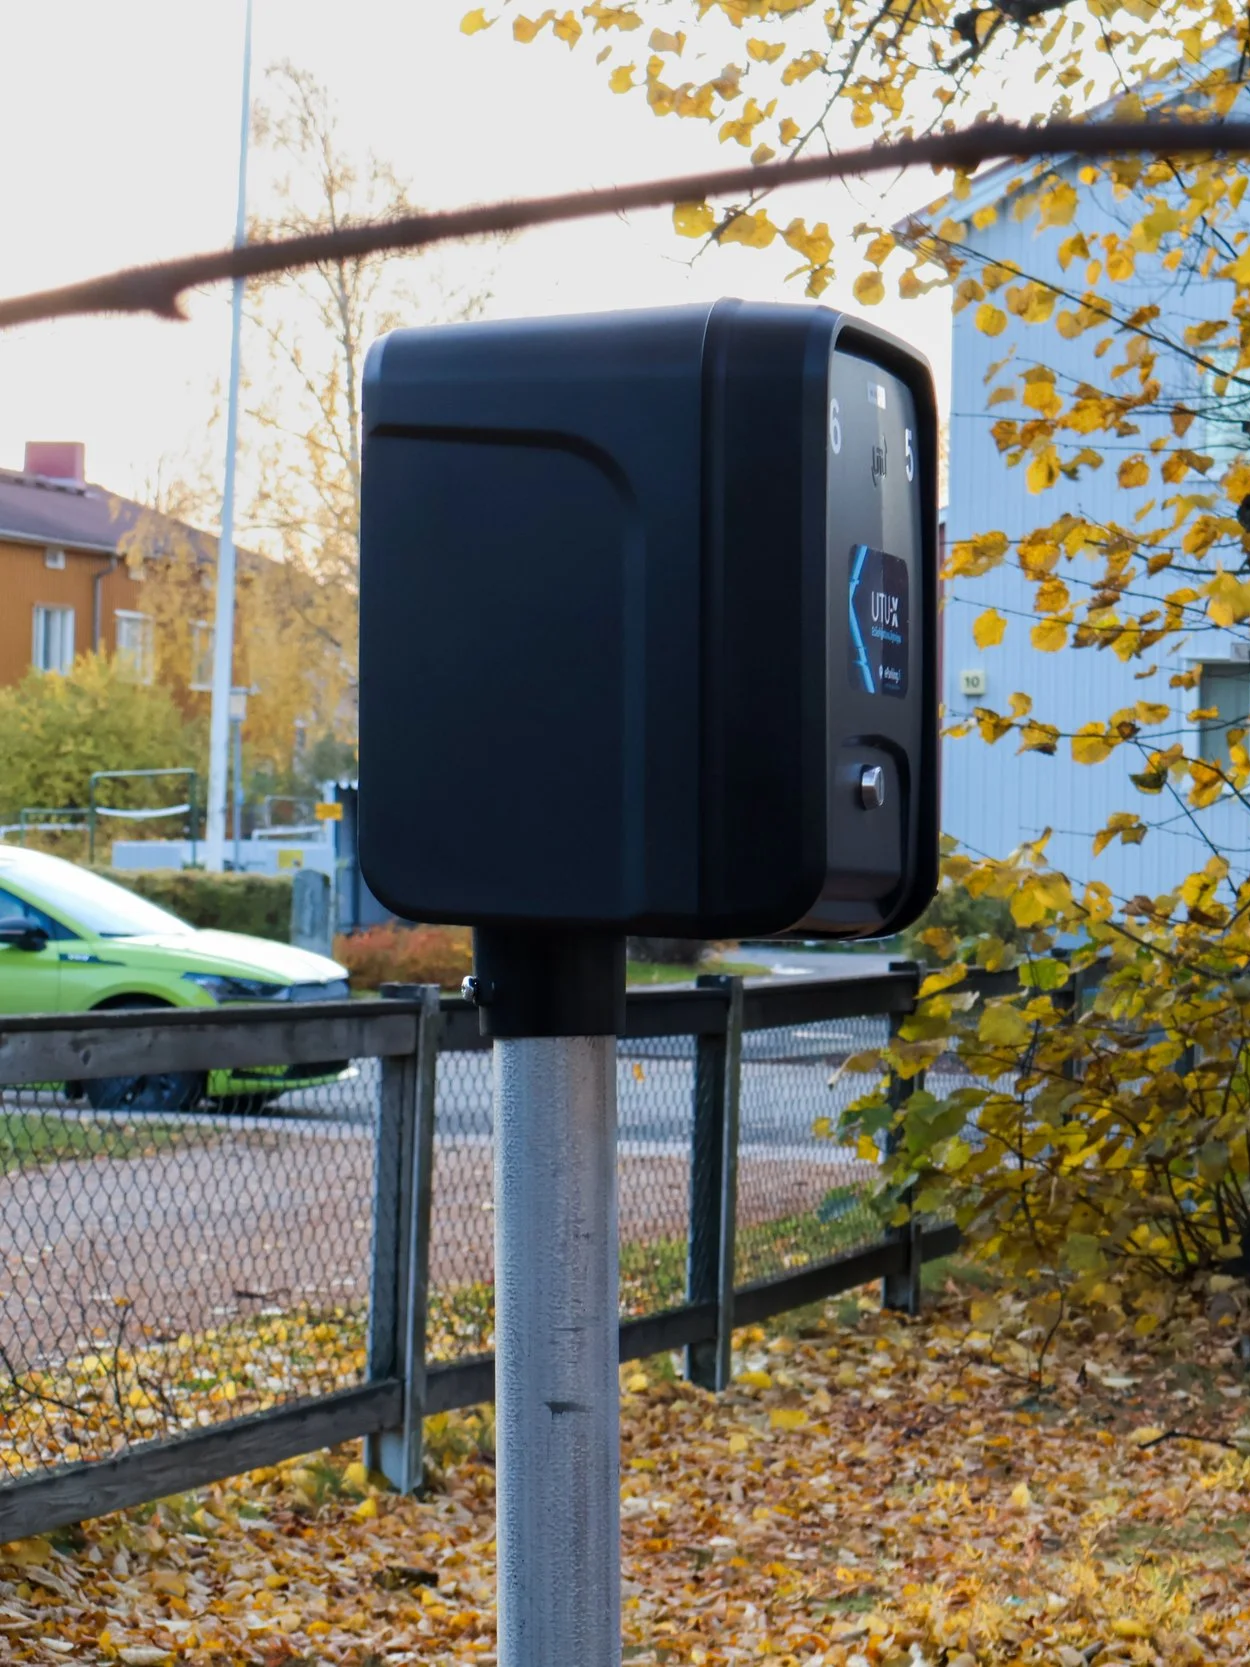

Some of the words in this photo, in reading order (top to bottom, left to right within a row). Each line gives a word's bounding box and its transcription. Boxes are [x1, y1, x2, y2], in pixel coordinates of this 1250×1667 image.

[829, 398, 842, 455] 6
[905, 428, 914, 482] 5
[964, 675, 981, 688] 10
